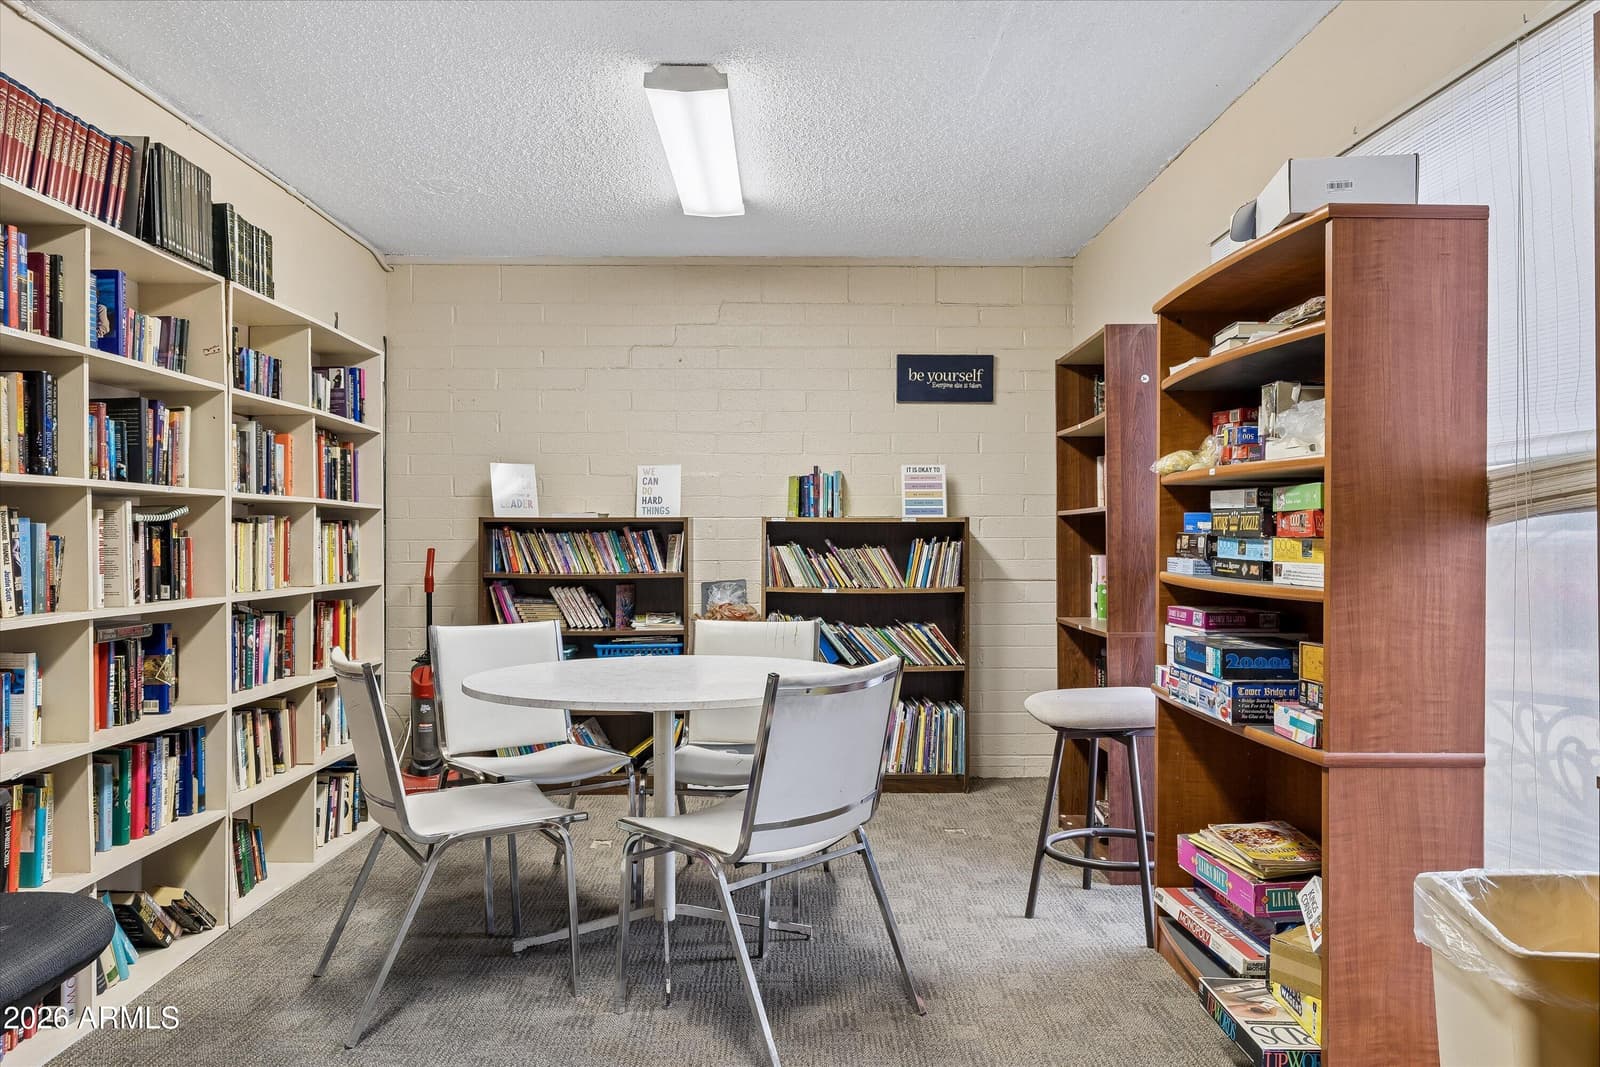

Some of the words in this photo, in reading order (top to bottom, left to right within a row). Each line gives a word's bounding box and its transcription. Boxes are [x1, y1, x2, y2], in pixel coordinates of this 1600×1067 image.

[908, 367, 925, 382] be
[926, 367, 985, 385] yourself
[1242, 433, 1255, 441] 500
[643, 467, 656, 476] WE
[642, 477, 659, 486] CAN
[642, 487, 653, 495] DO
[641, 496, 663, 505] HARD
[642, 506, 671, 516] THINGS
[1237, 686, 1262, 696] Tower
[1263, 686, 1287, 698] Bridge
[1288, 686, 1297, 697] of
[1178, 910, 1212, 945] MONOPOLY
[1206, 991, 1237, 1042] UPWORDS
